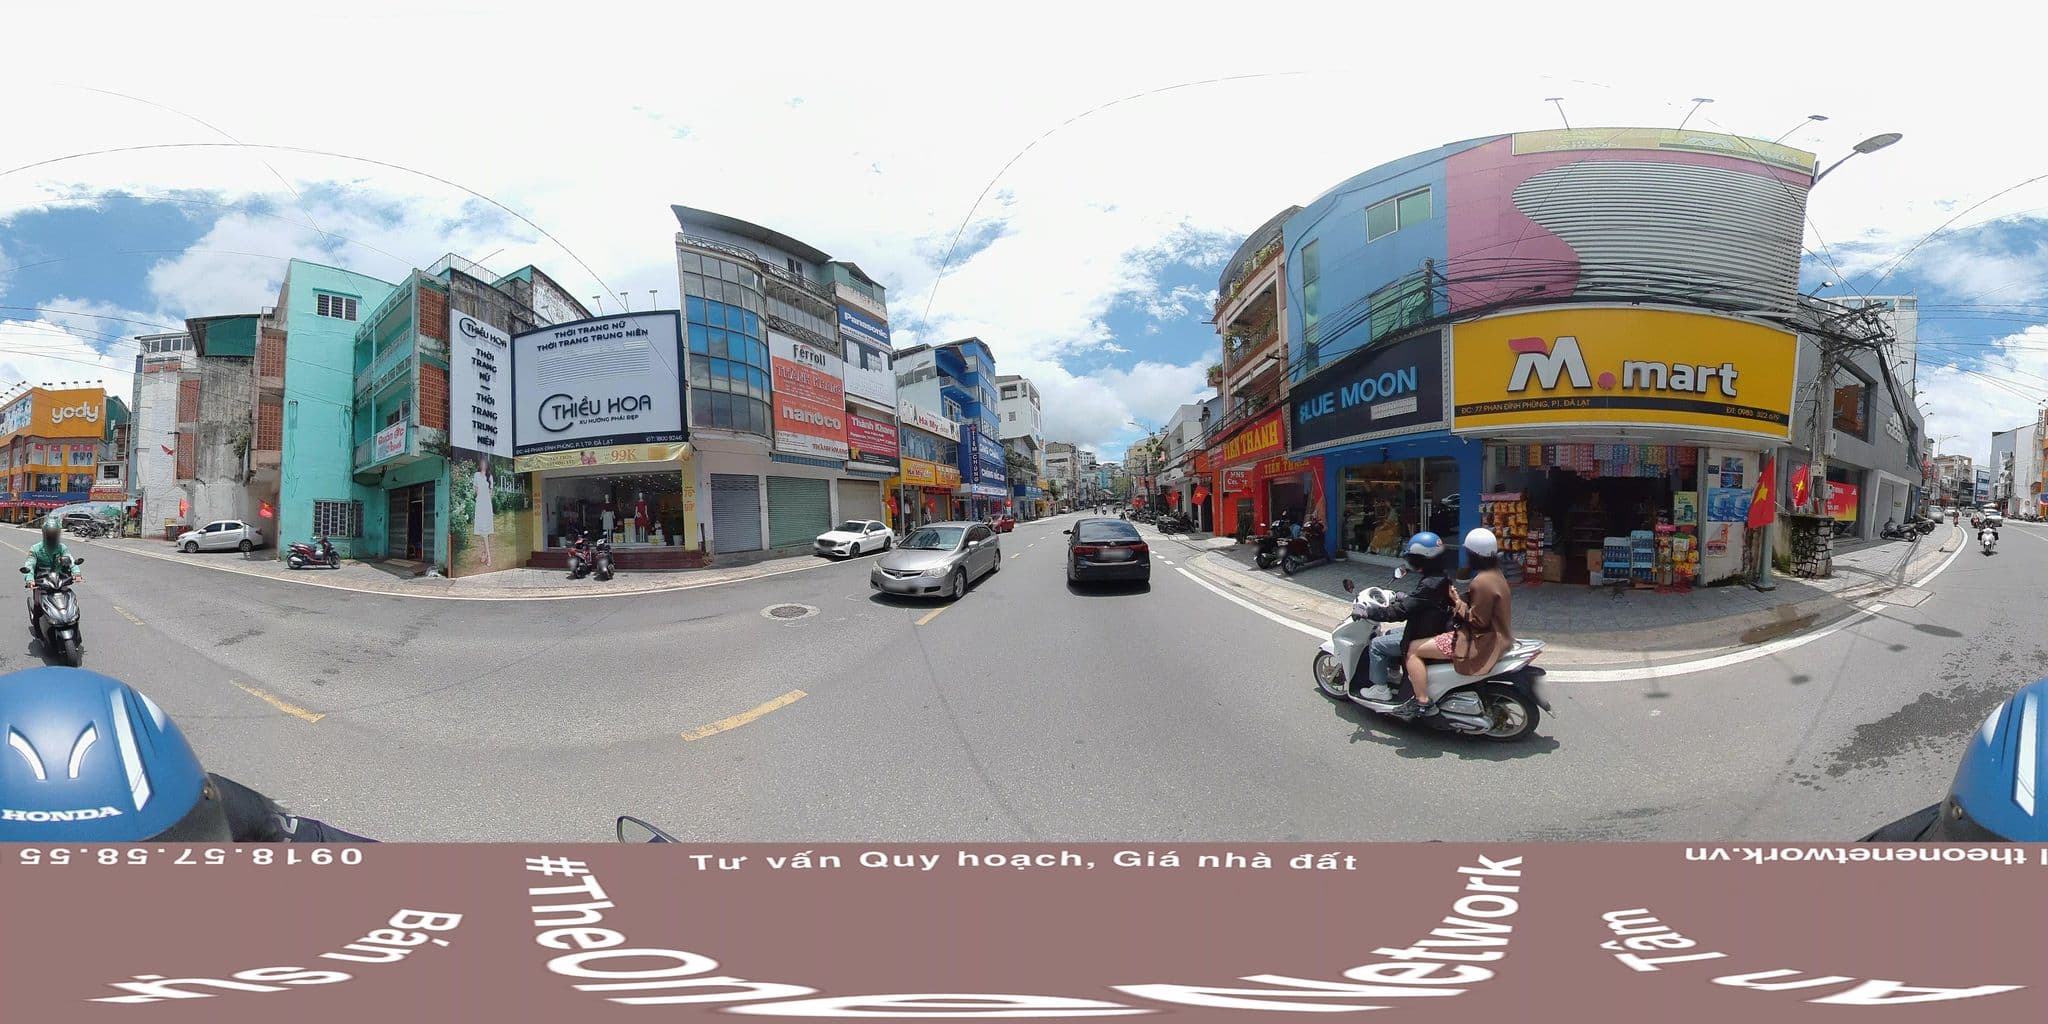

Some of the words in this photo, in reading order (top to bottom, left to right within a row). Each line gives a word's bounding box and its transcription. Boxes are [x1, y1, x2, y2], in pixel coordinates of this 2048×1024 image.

[554, 329, 576, 339] THỜI
[579, 323, 609, 334] TRANG
[612, 321, 626, 329] NỮ
[844, 312, 888, 339] Panasonic
[490, 333, 507, 348] HOA
[537, 340, 557, 352] THỜI
[559, 336, 589, 347] TRANG
[591, 332, 623, 342] TRUNG
[626, 328, 648, 337] NIÊN
[476, 348, 495, 361] THỜI
[471, 356, 497, 373] TRANG
[1341, 366, 1418, 408] MOON
[476, 392, 495, 406] THỜI
[52, 401, 98, 423] yody
[472, 405, 498, 420] TRANG
[552, 396, 600, 421] THIỀU
[608, 395, 652, 413] HOA
[1483, 404, 1502, 412] PHAN
[782, 405, 841, 430] nanoco
[472, 420, 498, 435] TRUNG
[611, 448, 637, 461] 99K
[2, 806, 122, 822] HONDA
